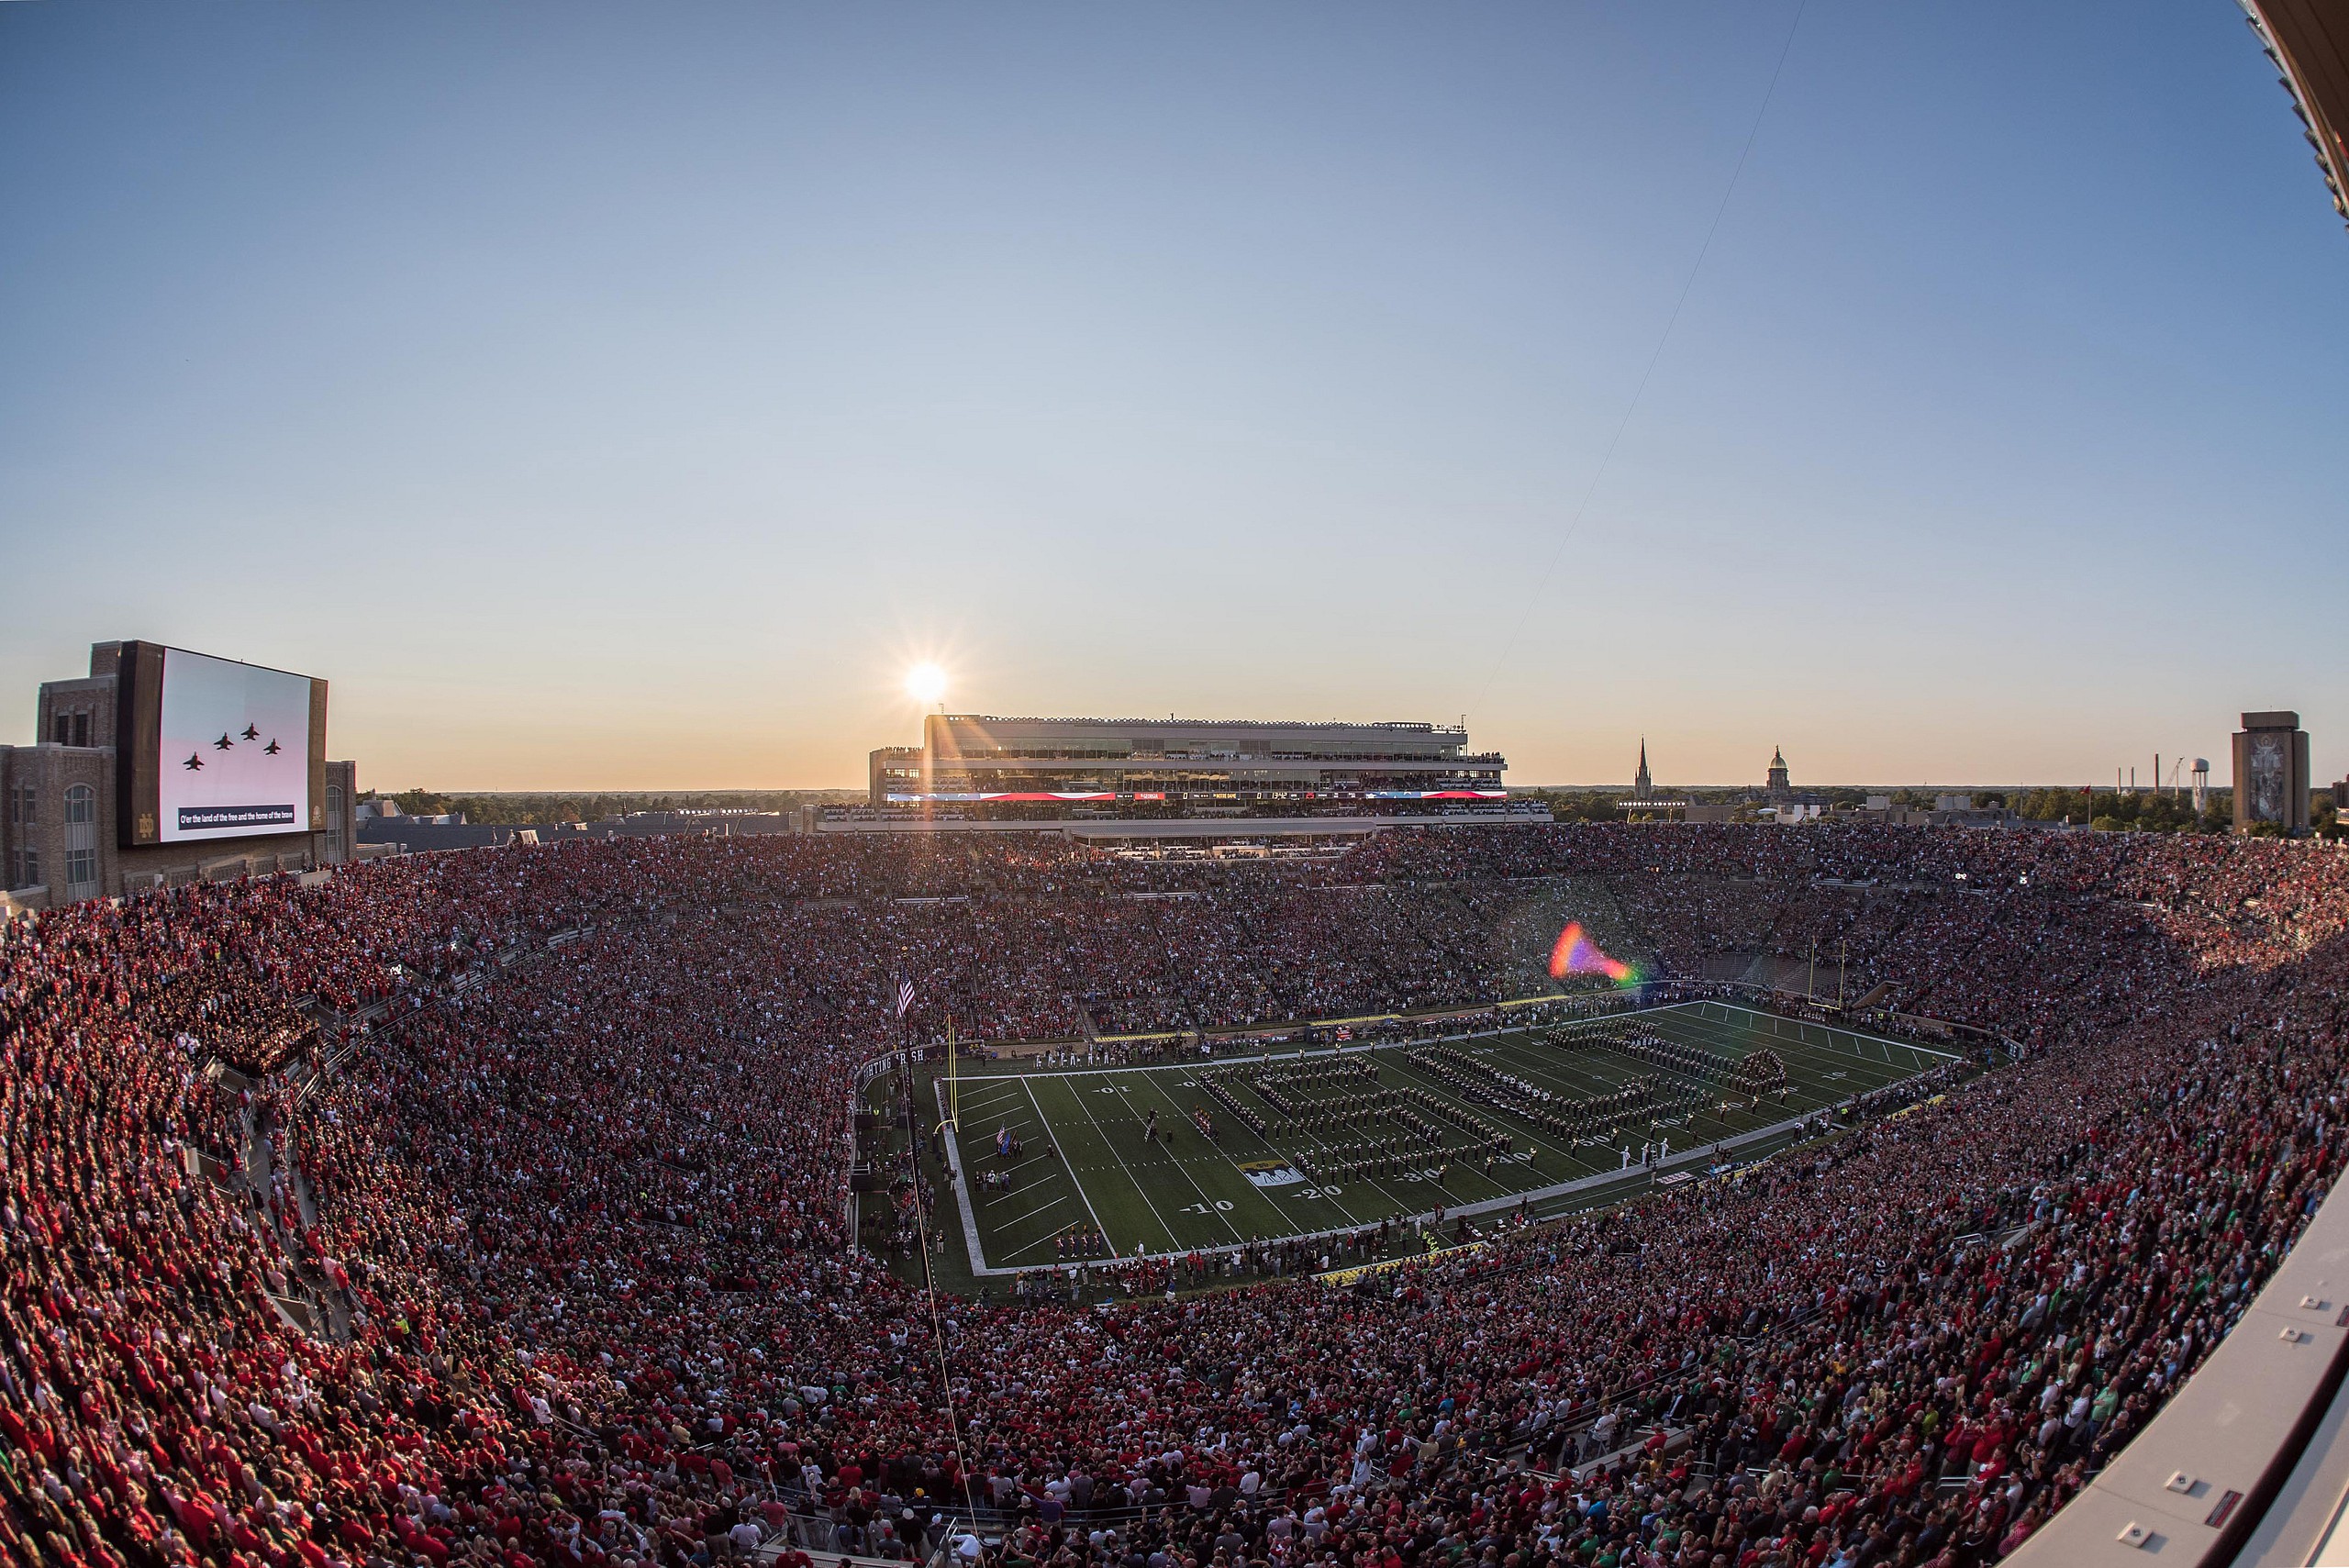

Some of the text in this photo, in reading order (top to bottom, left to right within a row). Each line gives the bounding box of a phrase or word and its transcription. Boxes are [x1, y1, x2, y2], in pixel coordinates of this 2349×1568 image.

[193, 814, 201, 823] the
[201, 813, 213, 822] land
[219, 813, 228, 822] the
[238, 812, 247, 821] and
[247, 811, 255, 820] the
[896, 1049, 924, 1064] RSH
[1301, 1185, 1342, 1199] 20
[1190, 1199, 1234, 1215] 10
